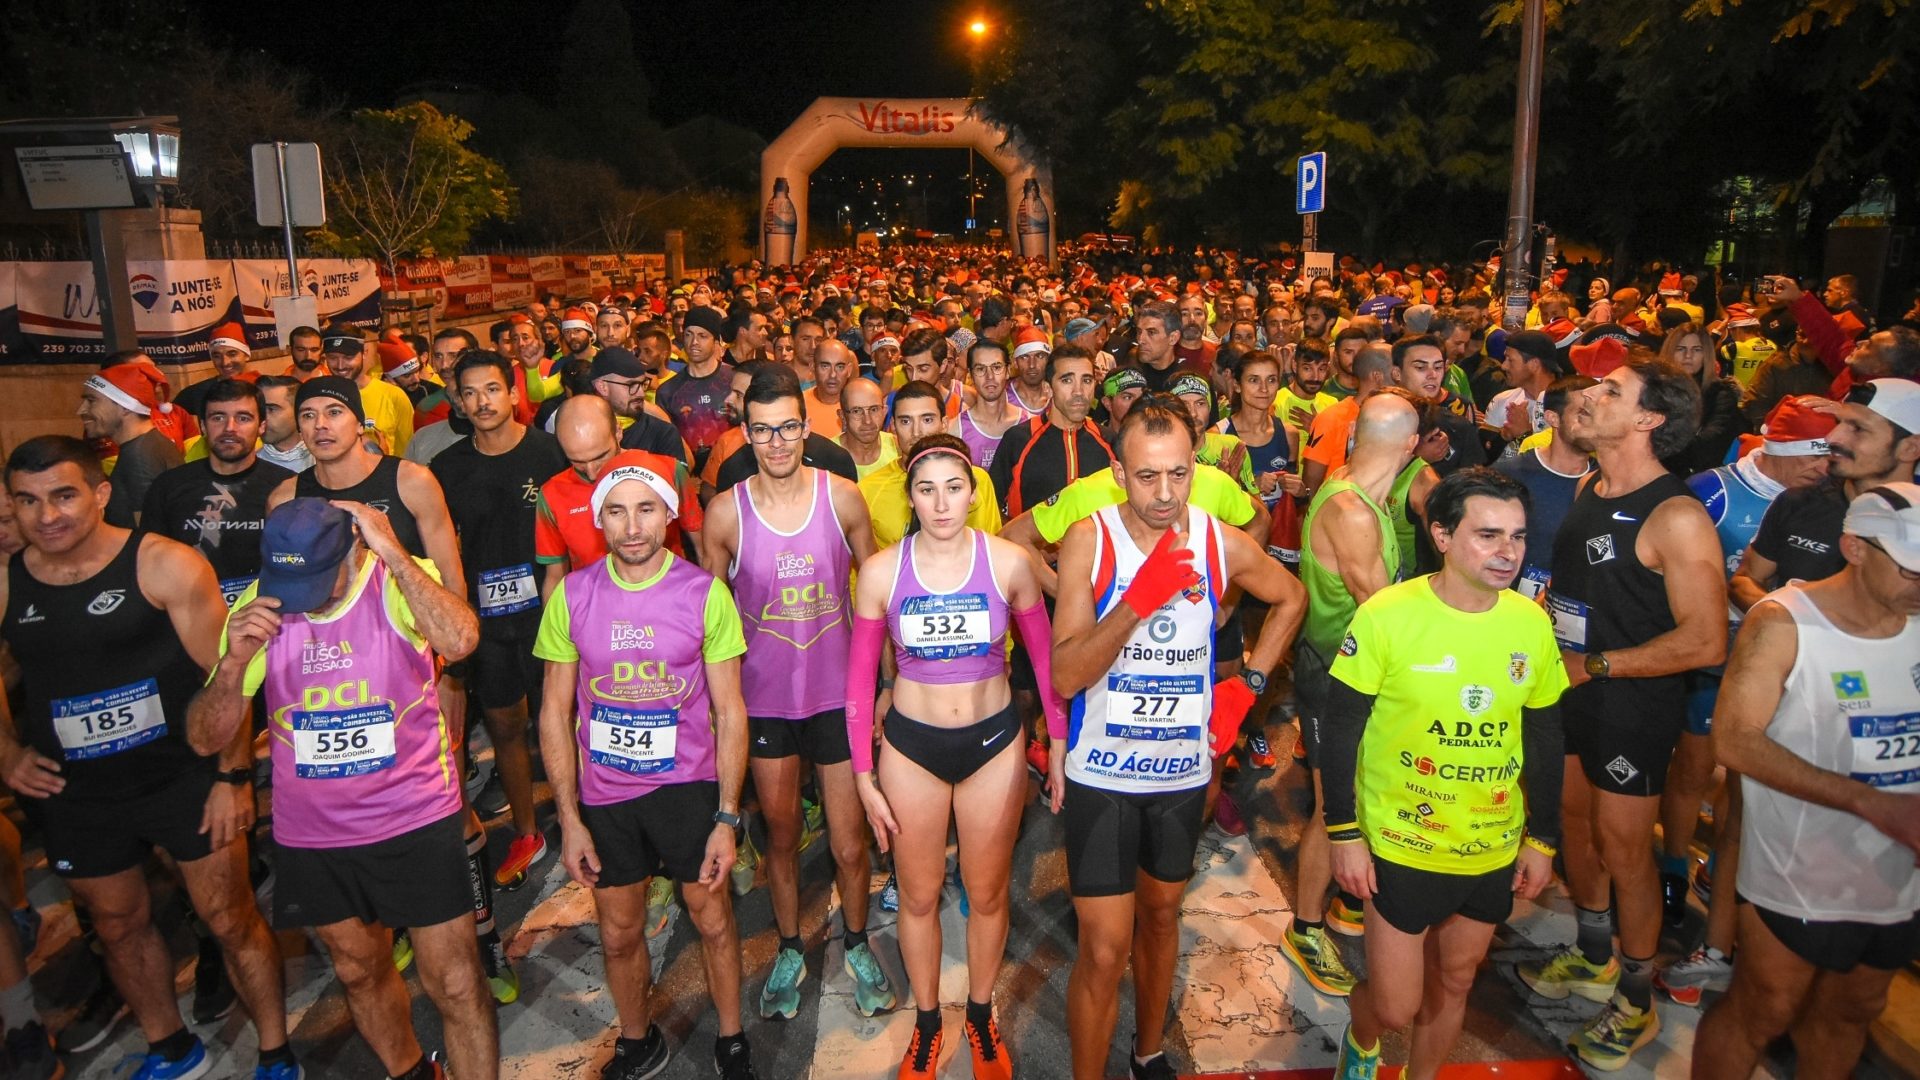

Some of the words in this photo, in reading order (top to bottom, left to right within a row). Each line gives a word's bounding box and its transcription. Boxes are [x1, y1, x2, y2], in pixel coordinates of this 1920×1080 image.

[858, 100, 955, 133] Vitalis
[1302, 159, 1318, 209] P
[167, 276, 223, 296] JUNTE-SE
[322, 271, 360, 286] JUNTE-SE
[323, 290, 331, 300] A
[332, 283, 350, 299] NÓS!
[170, 300, 185, 314] A
[187, 294, 216, 312] NÓS!
[256, 331, 269, 340] 239
[43, 344, 65, 354] 239
[69, 345, 91, 354] 702
[94, 345, 106, 354] 32
[1787, 534, 1831, 553] FYKE
[777, 558, 806, 572] LUSO
[777, 567, 815, 580] BUSSACO
[486, 580, 519, 599] 794
[922, 614, 967, 635] 532
[611, 629, 645, 642] LUSO
[916, 635, 941, 643] DANIELA
[942, 633, 974, 642] ASSUNÇÃO
[611, 640, 655, 651] BUSSACO
[302, 645, 341, 664] LUSO
[302, 658, 353, 675] BUSSACO
[105, 695, 135, 708] COIMBRA
[1132, 696, 1180, 716] 277
[80, 705, 135, 735] 185
[343, 719, 370, 728] COIMBRA
[371, 715, 387, 723] 2023
[358, 709, 386, 717] SILVESTRE
[83, 734, 96, 742] RUI
[96, 724, 137, 739] RODRIGUES
[316, 728, 368, 753] 556
[610, 726, 653, 750] 554
[608, 744, 629, 755] MANUEL
[1438, 737, 1503, 748] PEDRALVA
[1875, 735, 1920, 761] 222
[341, 748, 376, 758] GODINHO
[1086, 748, 1118, 768] RD
[1119, 751, 1200, 774] ÁGUEDA
[1084, 765, 1107, 777] AMAMOS
[1138, 774, 1177, 782] AMBICIONAMOS
[1404, 781, 1457, 801] MIRANDA
[1402, 837, 1434, 851] AUTO
